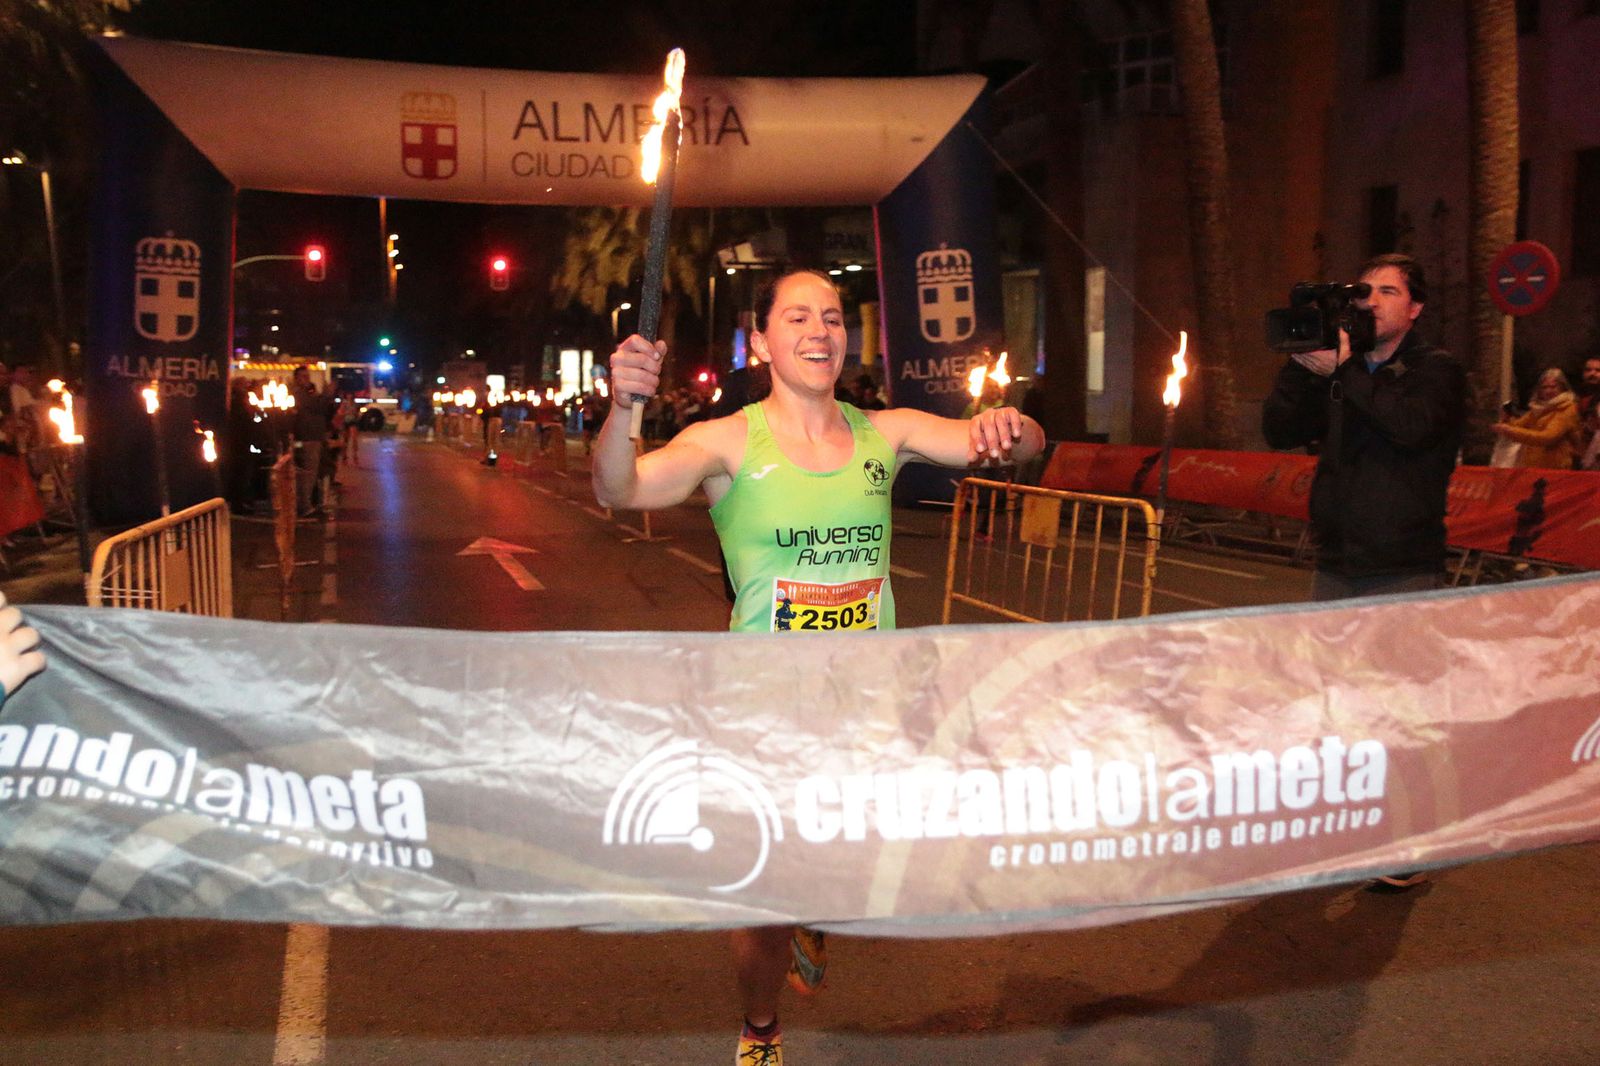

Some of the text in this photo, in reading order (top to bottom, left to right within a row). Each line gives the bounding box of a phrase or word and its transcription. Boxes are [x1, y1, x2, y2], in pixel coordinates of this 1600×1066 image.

[511, 151, 634, 178] CIUDAD
[107, 353, 220, 381] ALMERÍA
[776, 524, 884, 548] Universo
[797, 546, 880, 567] Running
[800, 602, 868, 630] 2503
[989, 806, 1383, 869] cronometraje deportivo
